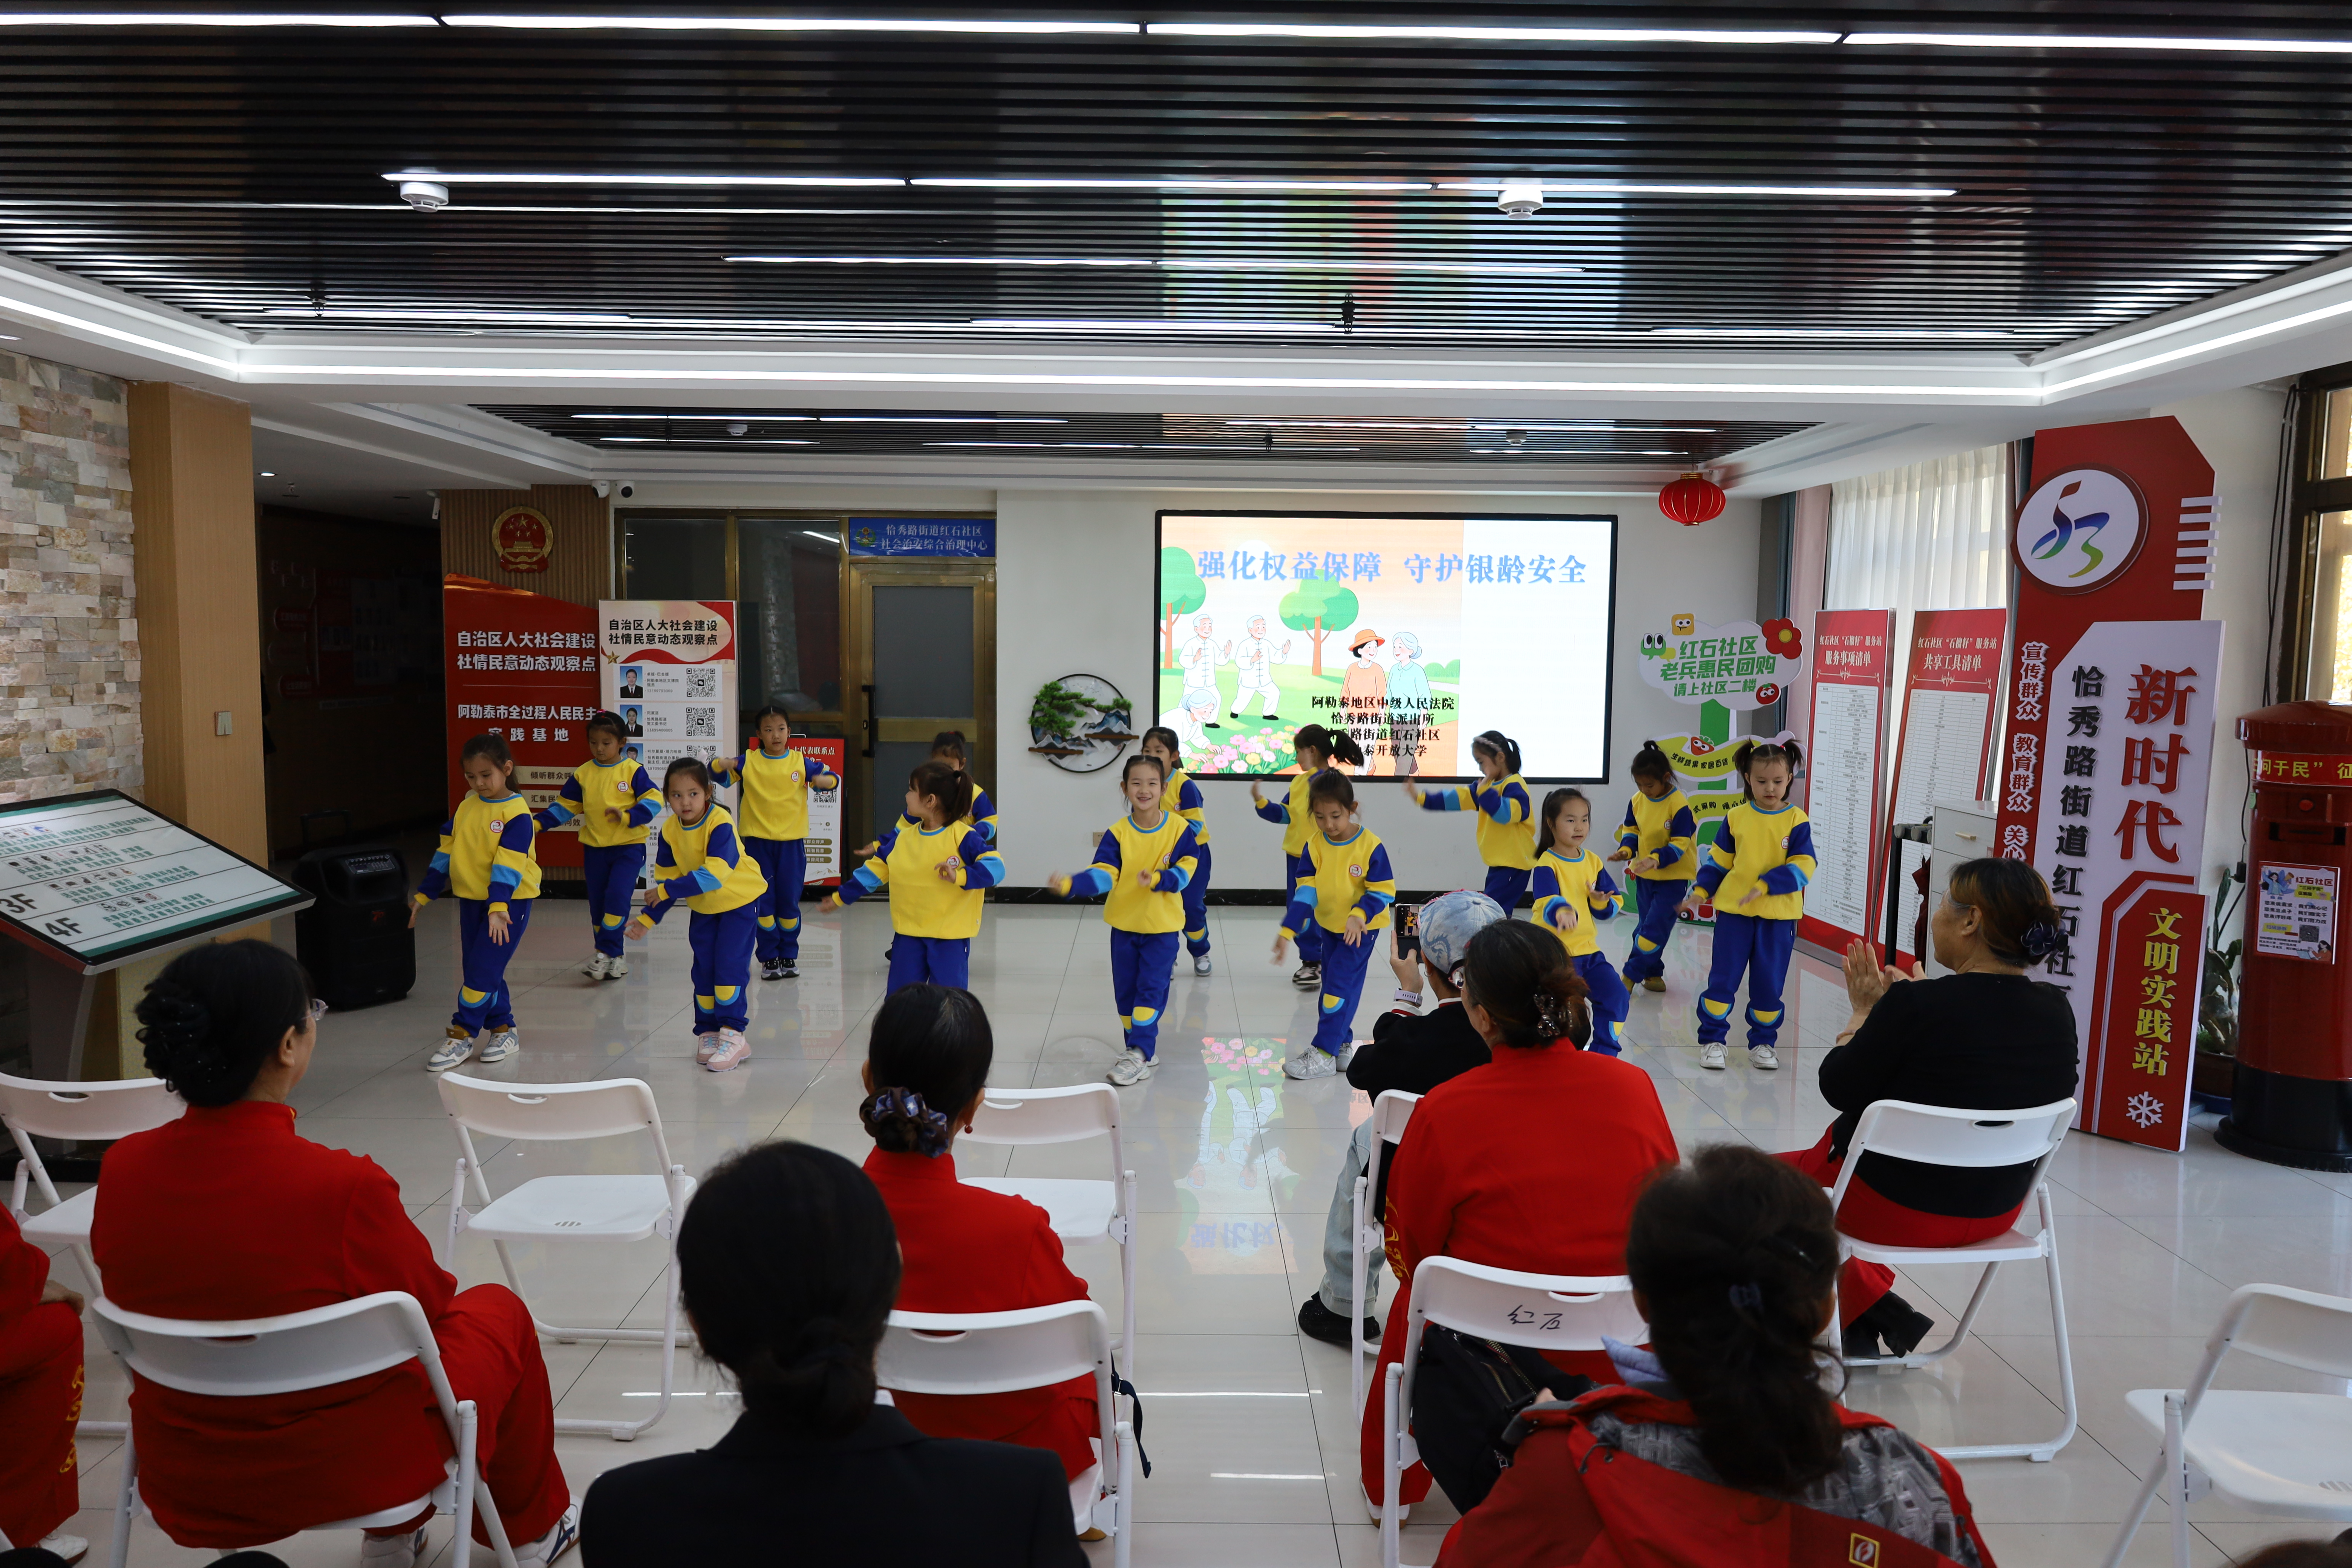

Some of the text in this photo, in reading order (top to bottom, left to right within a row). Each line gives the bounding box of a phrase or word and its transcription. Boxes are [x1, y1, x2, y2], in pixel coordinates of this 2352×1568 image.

[887, 524, 982, 536] 恰秀路街道红石社区
[1197, 550, 1586, 585] 强化权益保障 守护银龄安全
[609, 619, 718, 632] 自治区人大社会建设
[457, 631, 596, 649] 自治区人大社会建设
[609, 633, 718, 646] 社情民意动态观察点
[1679, 635, 1758, 660] 红石社区
[457, 654, 596, 672] 社情民意动态观察点
[1825, 650, 1871, 667] 服务事项清单
[1923, 654, 1982, 672] 共享工具清单
[1660, 655, 1776, 681] 老兵惠民团购
[1674, 678, 1757, 697] 请上社区二楼
[2017, 642, 2048, 720] 宣传群众
[1312, 696, 1455, 710] 阿勒泰地区中级人民法院
[458, 704, 596, 721] 阿勒泰市全过程人民民主
[1331, 712, 1435, 726] 恰秀路街道派出所
[1357, 744, 1427, 757] 泰开放大学
[1701, 758, 1728, 769] 家居百货
[2007, 733, 2037, 812] 教育群众
[2114, 664, 2198, 863] 新时代
[2044, 665, 2105, 996] 恰秀路街道红石社
[2296, 877, 2333, 886] 红石社区
[0, 893, 37, 913] 3F
[44, 917, 83, 937] 4F
[2132, 907, 2183, 1076] 文明实践站
